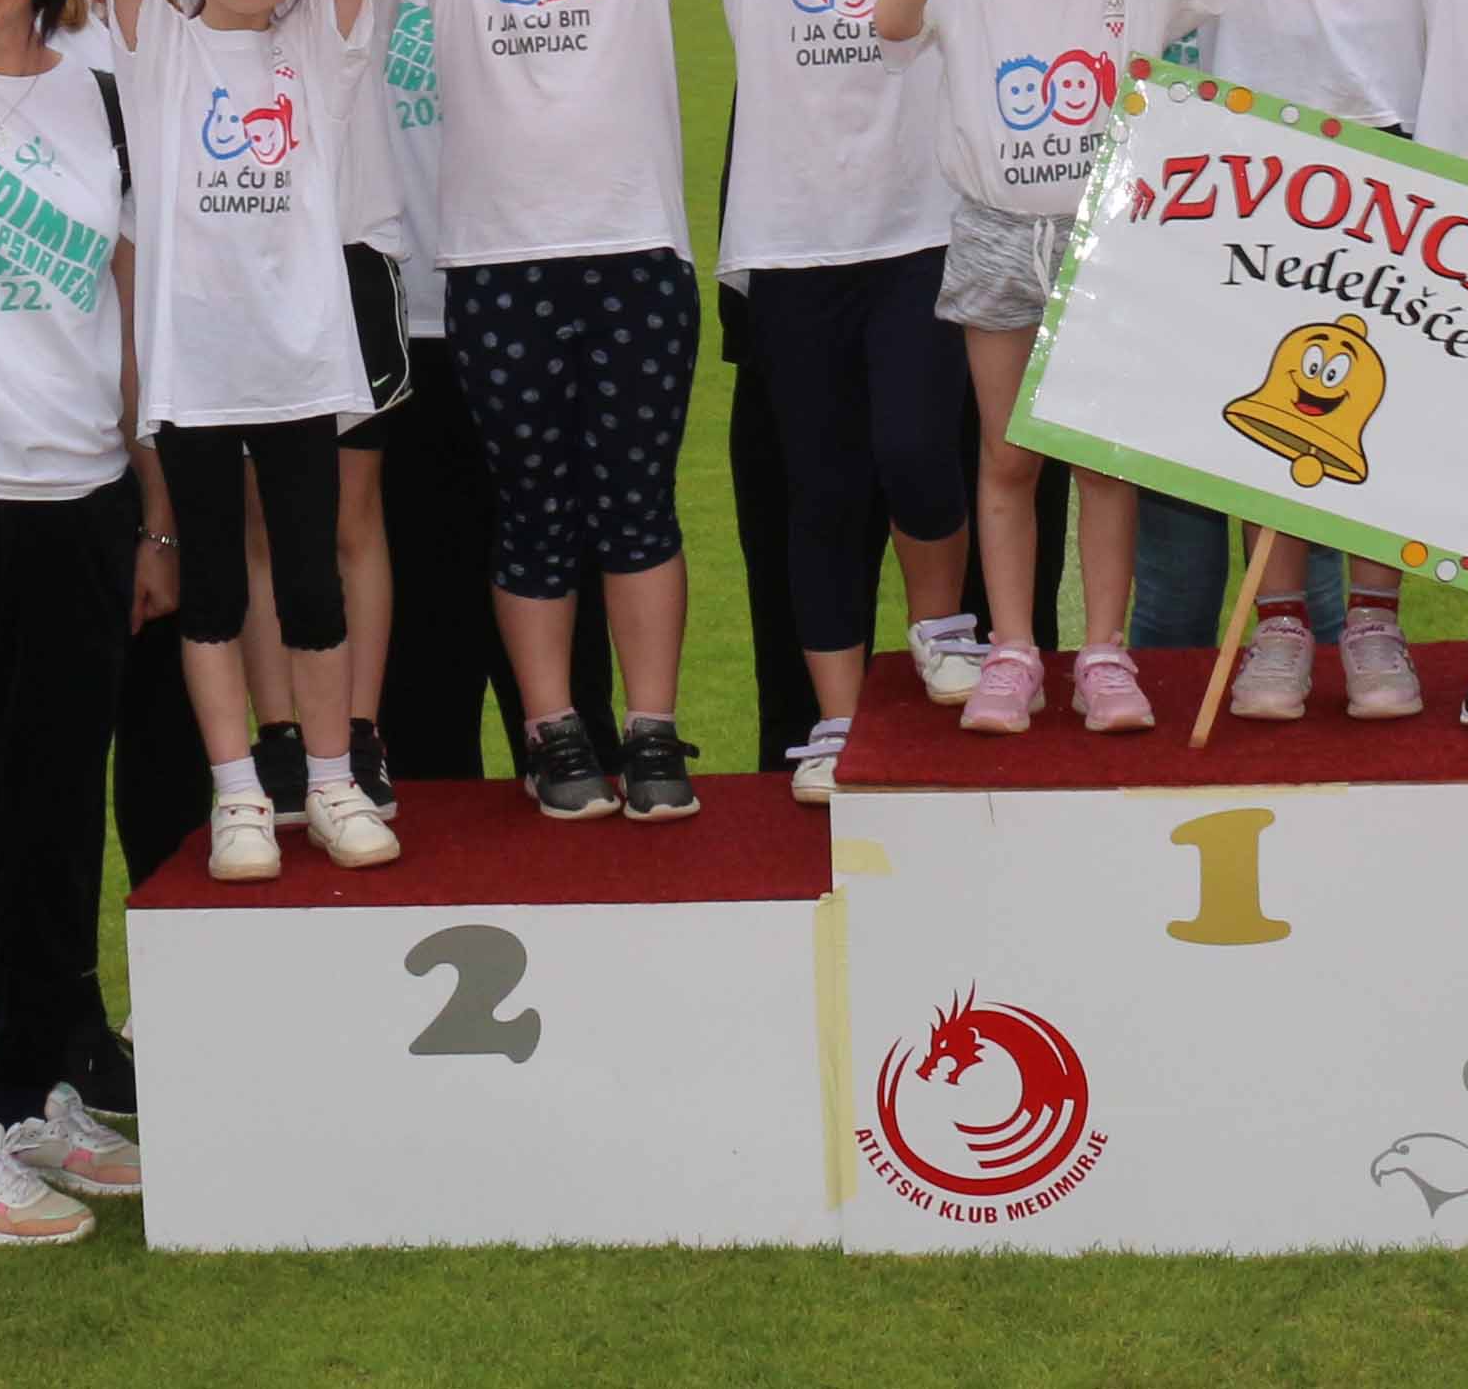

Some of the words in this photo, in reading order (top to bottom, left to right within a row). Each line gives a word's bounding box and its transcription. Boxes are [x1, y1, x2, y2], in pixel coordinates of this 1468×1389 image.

[487, 15, 493, 32] I
[500, 13, 518, 32] JA
[559, 9, 590, 28] BITI
[791, 26, 796, 43] I
[803, 23, 826, 43] JA
[833, 17, 861, 40] ĆU
[492, 33, 589, 56] OLIMPIJAC
[796, 44, 883, 67] OLIMPIJA
[1000, 143, 1005, 160] I
[1012, 141, 1035, 160] JA
[1043, 133, 1071, 156] ĆU
[1080, 132, 1105, 154] BIT
[197, 170, 202, 188] I
[207, 170, 228, 188] JA
[236, 165, 266, 189] ĆU
[1004, 160, 1092, 186] OLIMPIJA
[1166, 808, 1291, 945] 1
[404, 924, 542, 1064] 2
[854, 1128, 933, 1211] ATLETSKI
[939, 1200, 998, 1224] KLUB
[1005, 1130, 1109, 1222] MEĐIMURJE
